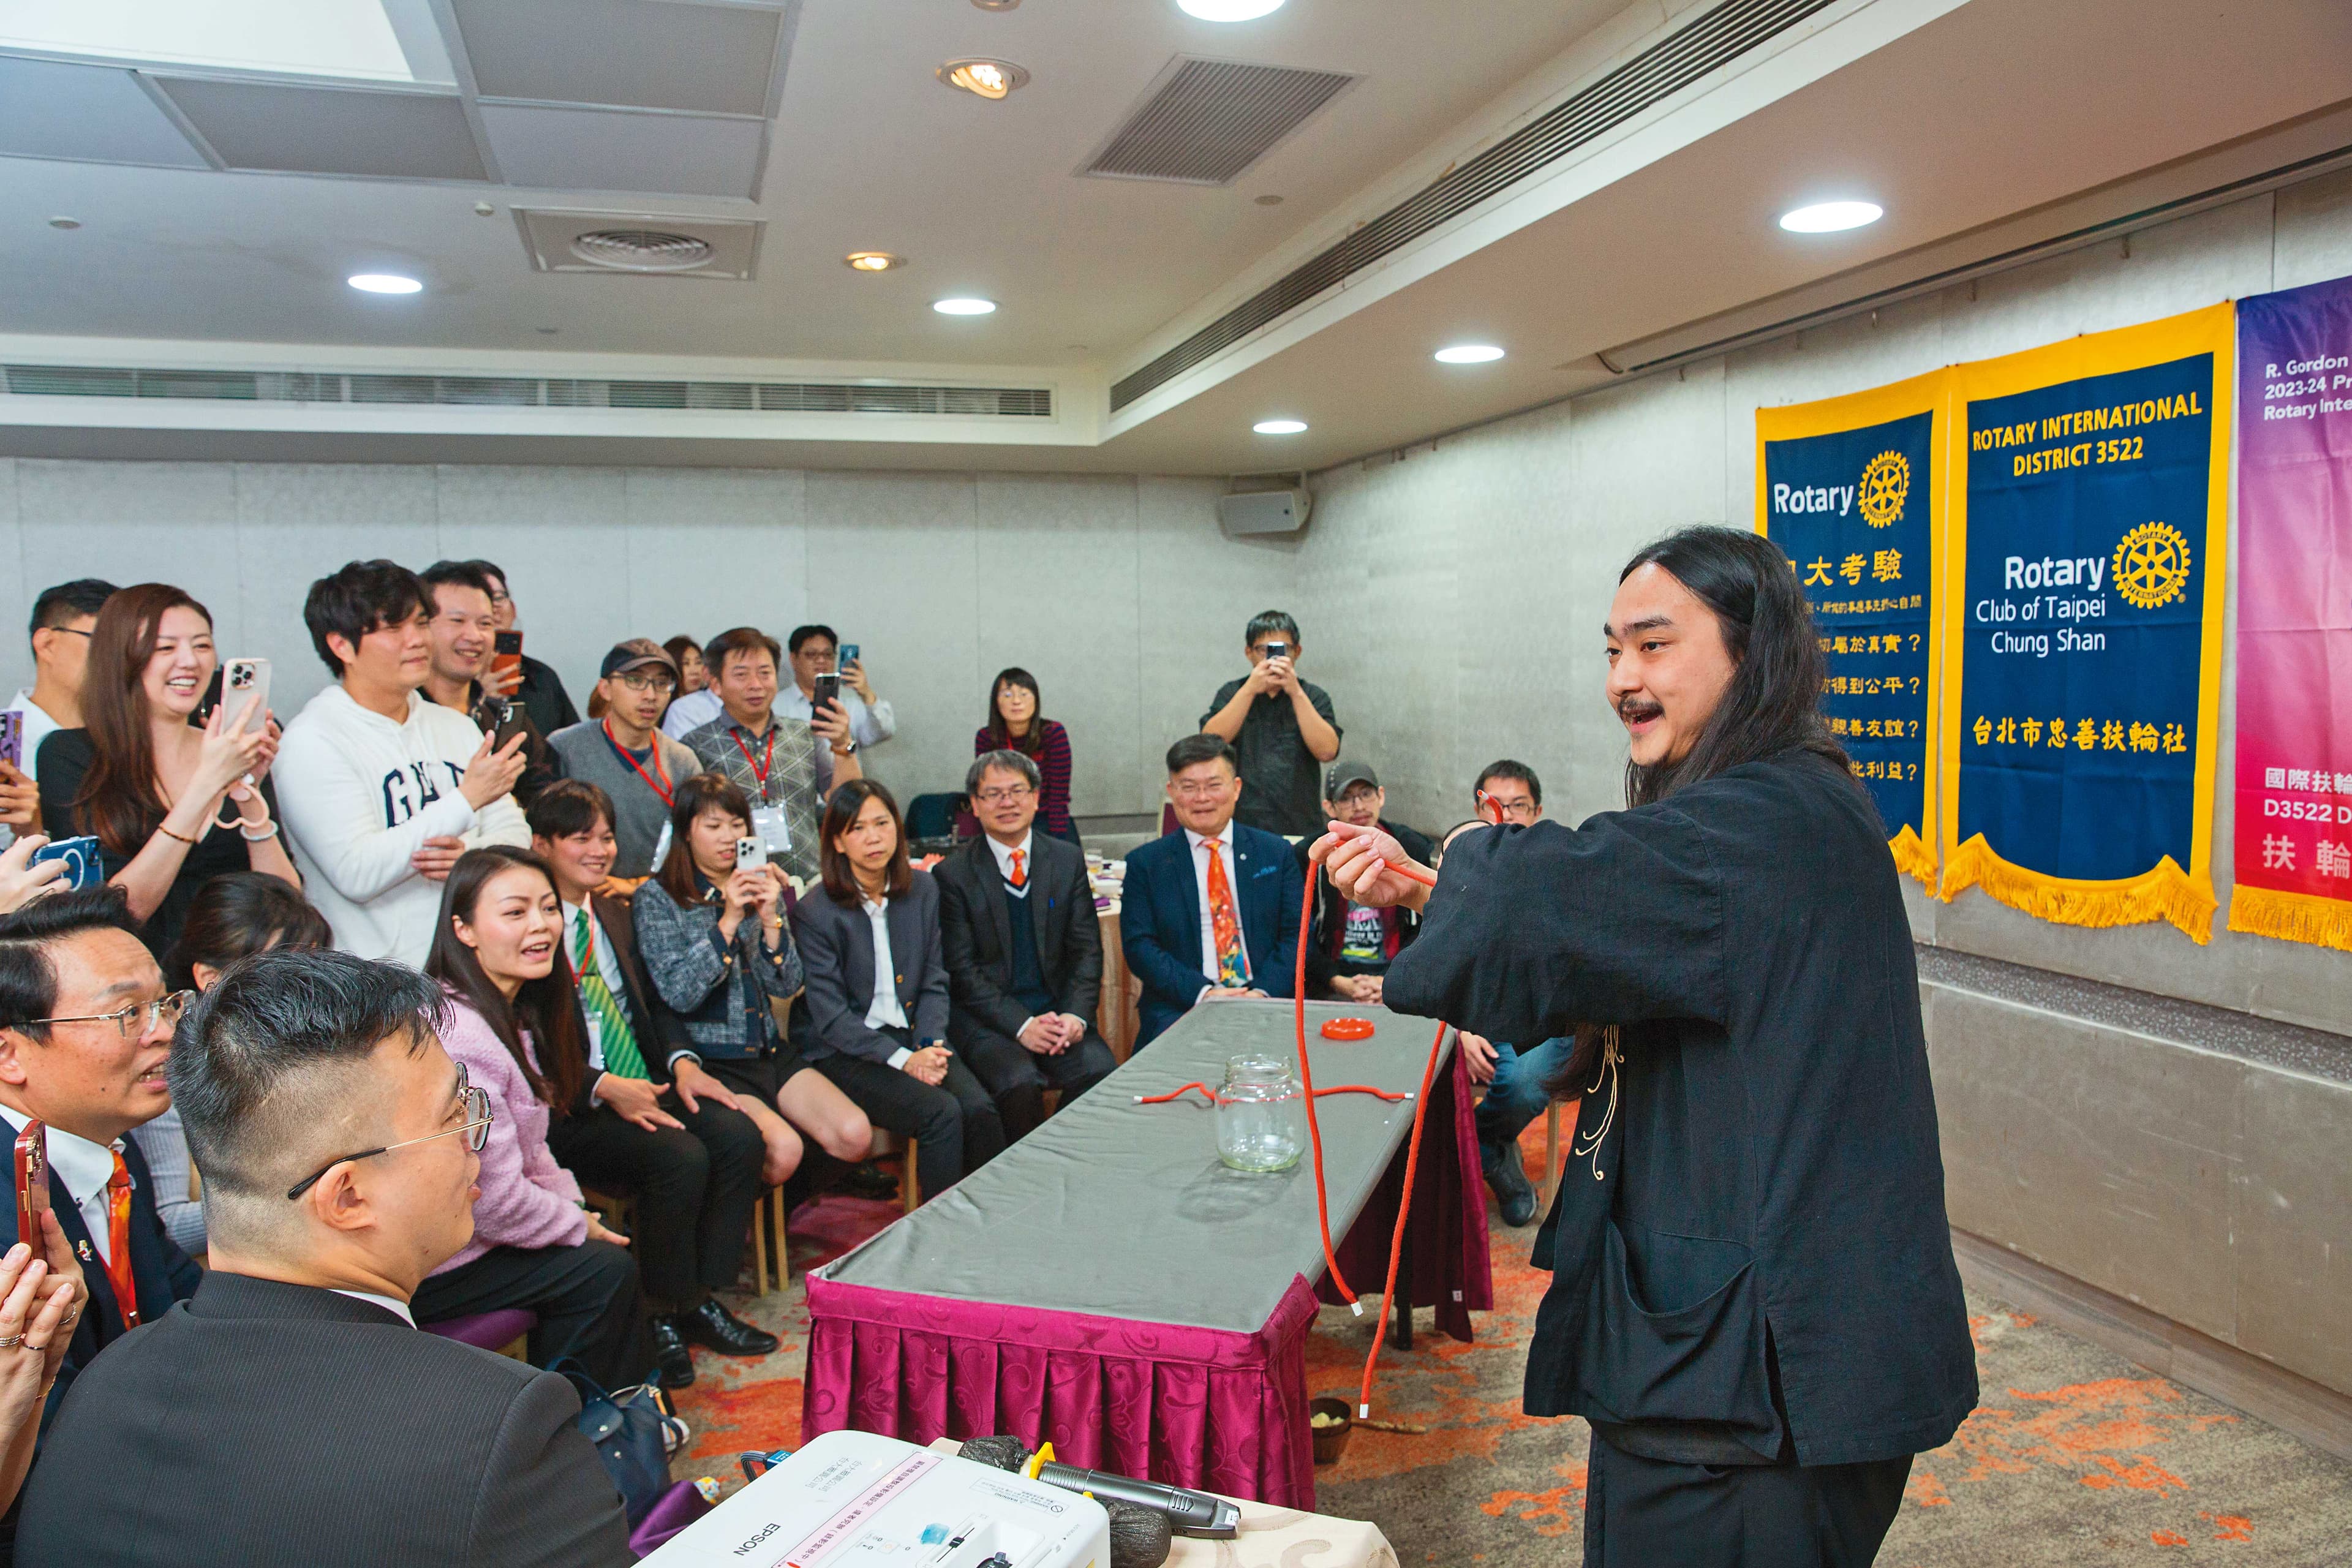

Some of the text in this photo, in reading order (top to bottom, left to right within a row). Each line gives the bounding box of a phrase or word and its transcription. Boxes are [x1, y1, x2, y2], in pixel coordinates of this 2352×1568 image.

[2266, 354, 2348, 379] R. Gordon
[2264, 375, 2327, 399] 2023-24
[1973, 391, 2203, 451] ROTARY INTERNATIONAL
[2264, 404, 2317, 420] Rotary
[2014, 436, 2144, 477] DISTRICT 3522
[1774, 483, 1854, 516] Rotary
[2005, 556, 2106, 592] Rotary
[1976, 593, 2106, 624] Club of Taipei
[1991, 627, 2106, 658] Chung Shan
[1972, 714, 2188, 755] 台北市忠善扶輪社
[2264, 798, 2332, 823] D3522
[733, 1523, 782, 1556] EPSON
